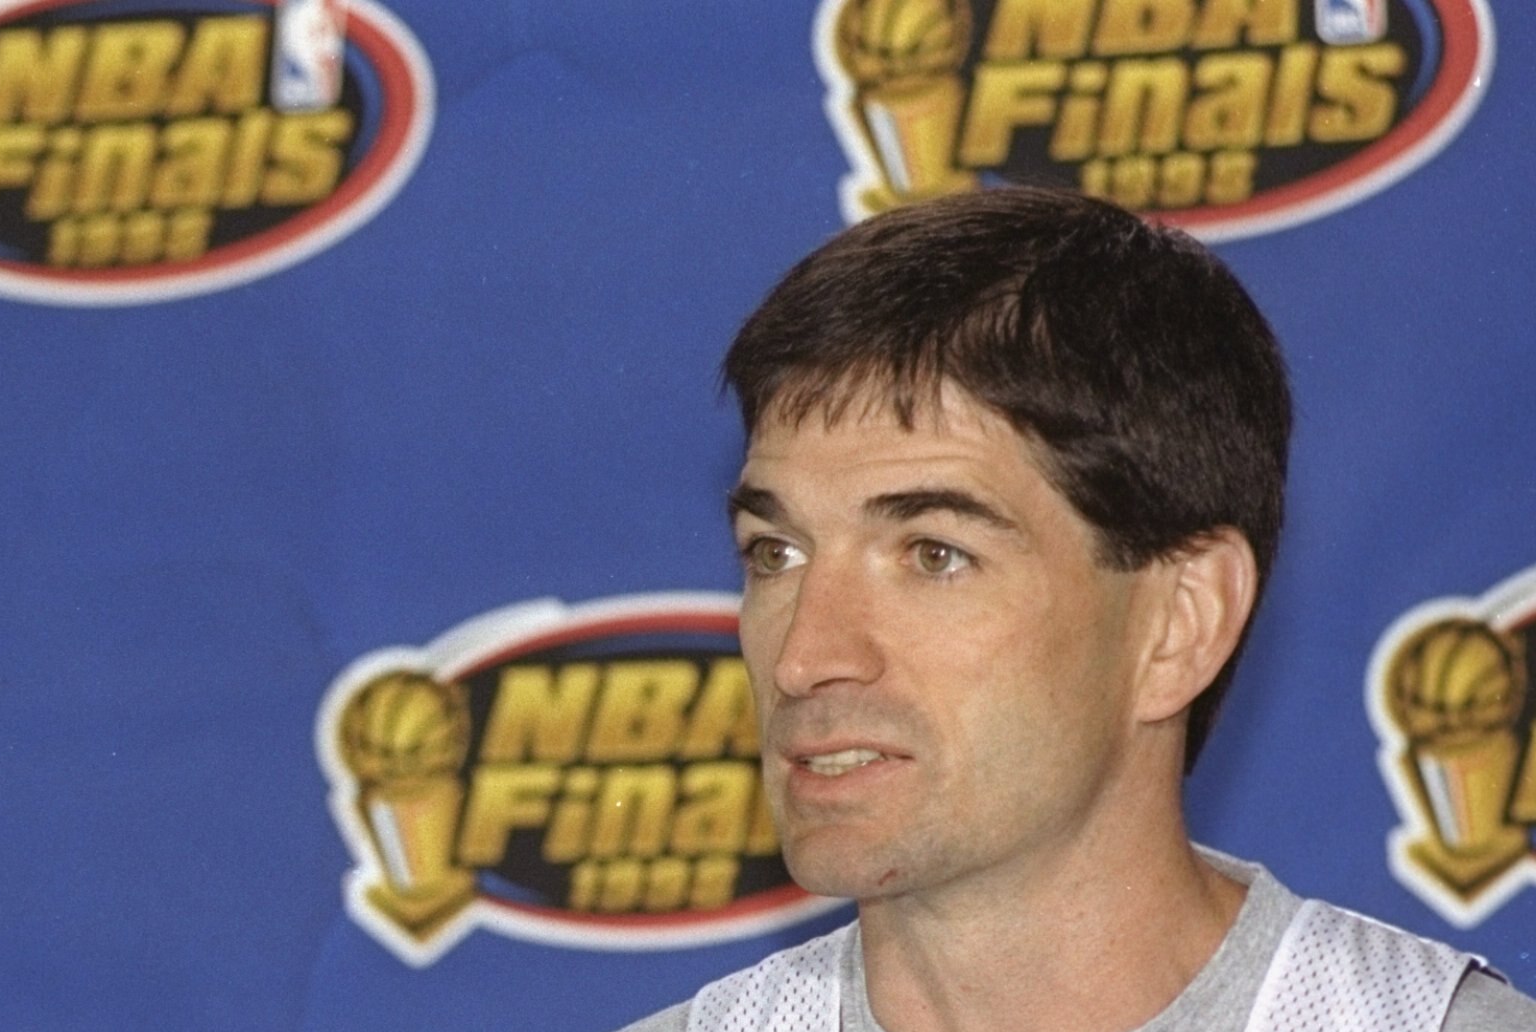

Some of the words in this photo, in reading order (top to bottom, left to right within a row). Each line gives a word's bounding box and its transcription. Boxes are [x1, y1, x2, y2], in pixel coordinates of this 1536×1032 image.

[959, 41, 1406, 167] Finals
[481, 655, 762, 764] NBA
[457, 759, 784, 867] Fina
